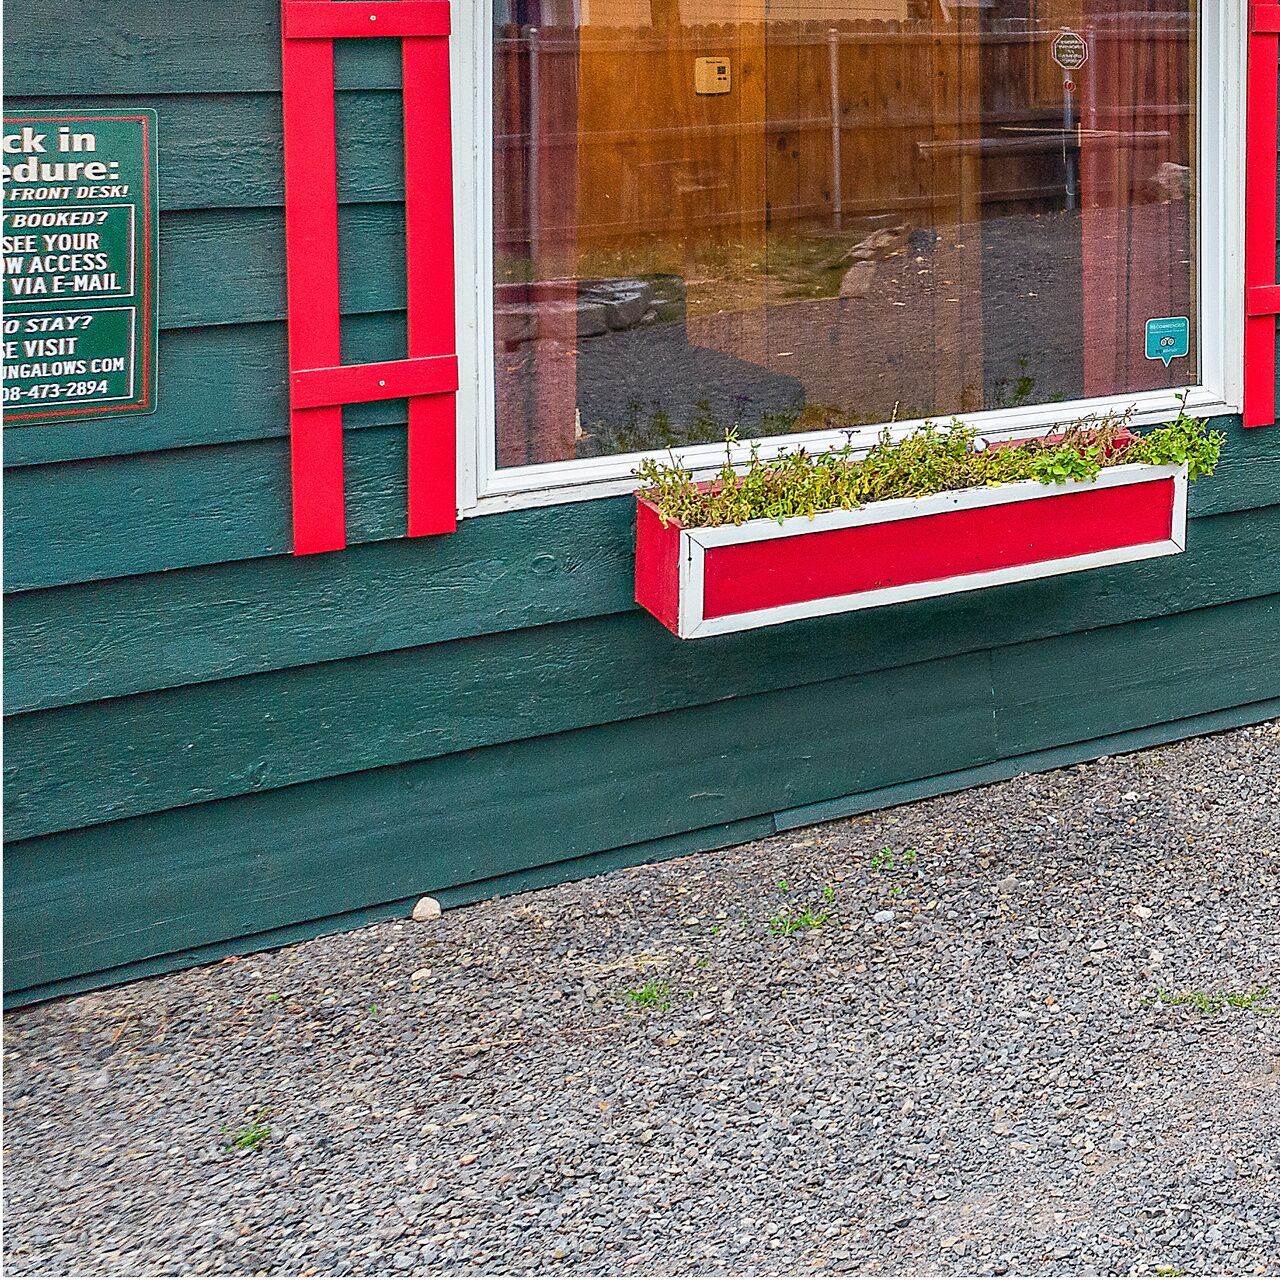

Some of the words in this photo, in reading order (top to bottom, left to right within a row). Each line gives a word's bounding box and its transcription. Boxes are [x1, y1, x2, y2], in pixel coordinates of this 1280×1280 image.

[59, 126, 96, 152] in
[10, 186, 73, 201] FRONT
[76, 185, 129, 198] DESK!
[12, 211, 108, 228] BOOKED?
[3, 235, 37, 253] SEE
[42, 233, 99, 251] YOUR
[28, 253, 108, 273] ACCESS
[11, 277, 47, 295] VIA
[52, 273, 121, 293] E-MAIL
[24, 315, 93, 333] STAY?
[23, 337, 78, 358] VISIT
